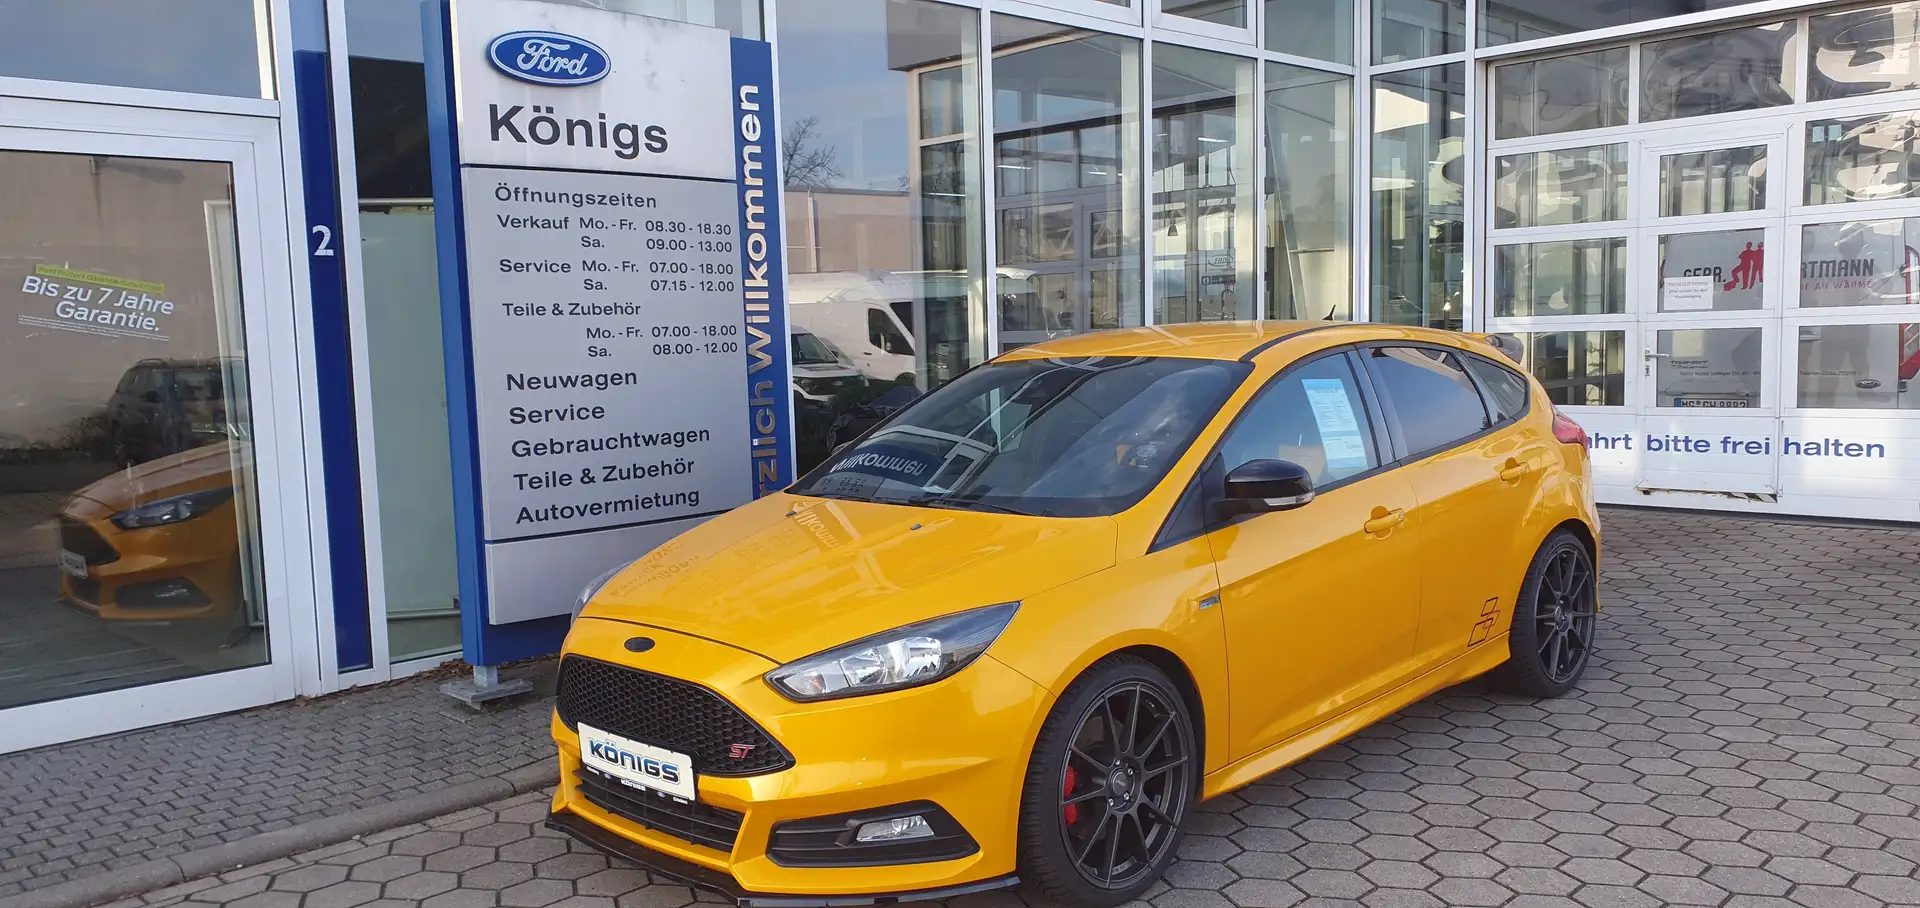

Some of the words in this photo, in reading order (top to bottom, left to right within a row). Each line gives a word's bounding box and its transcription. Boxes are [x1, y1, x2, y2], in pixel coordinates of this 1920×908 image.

[516, 39, 588, 76] Ford
[489, 104, 667, 159] Königs
[495, 182, 656, 208] Öffnungszeiten
[497, 215, 569, 229] Verkauf
[739, 84, 773, 374] Willkommen
[312, 225, 334, 256] 2
[581, 236, 604, 247] Sa.
[500, 259, 571, 273] Service
[22, 276, 61, 297] Bis
[63, 286, 92, 302] zu
[97, 288, 113, 304] 7
[114, 290, 174, 315] Jahre
[584, 279, 607, 290] Sa.
[56, 301, 160, 331] Garantie.
[502, 303, 546, 316] Teile
[552, 303, 564, 315] &
[569, 302, 640, 315] Zubehör
[588, 346, 611, 357] Sa.
[507, 373, 636, 390] Neuwagen
[510, 404, 604, 424] Service
[512, 430, 709, 459] Gebrauchtwagen
[1647, 435, 1711, 453] bitte
[1720, 436, 1770, 456] frei
[1784, 437, 1885, 458] halten
[513, 471, 572, 490] Teile
[580, 468, 596, 484] &
[603, 458, 694, 482] Zubehör
[516, 487, 700, 525] Autovermietung
[589, 739, 680, 783] KÖNIGS
[729, 744, 755, 758] ST
